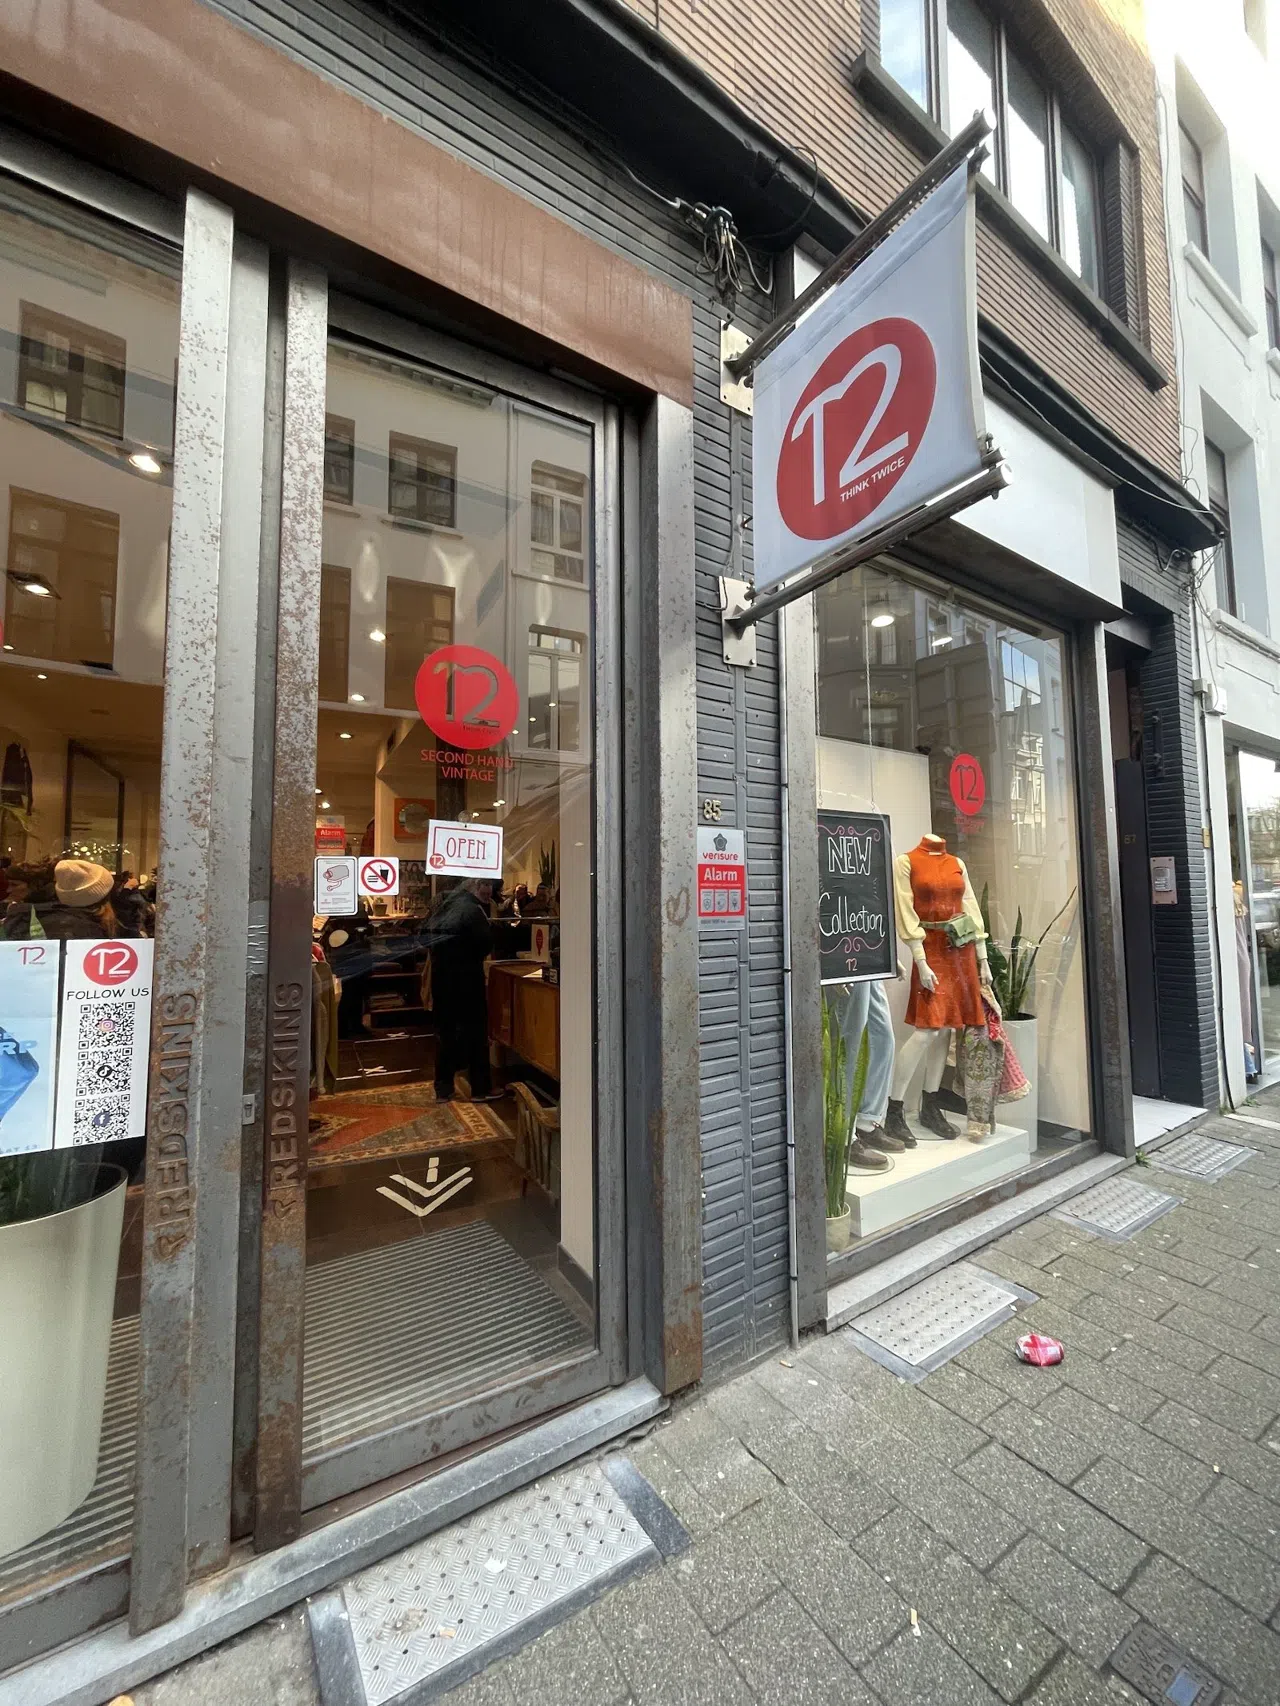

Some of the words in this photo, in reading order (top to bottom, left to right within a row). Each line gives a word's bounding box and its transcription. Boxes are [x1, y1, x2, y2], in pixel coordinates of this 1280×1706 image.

[840, 478, 870, 502] THINK
[871, 456, 905, 484] TWICE
[420, 749, 474, 766] SECOND
[477, 755, 514, 769] HAND
[441, 766, 496, 782] VINTAGE
[703, 799, 721, 821] 85
[446, 837, 487, 860] OPEN
[702, 851, 739, 861] verisure
[827, 836, 872, 876] NEW
[704, 867, 738, 881] Alarm
[818, 892, 886, 938] Collection
[66, 988, 126, 1001] FOLLOW
[131, 987, 150, 997] US
[269, 982, 304, 1191] REDSKINS
[154, 992, 198, 1229] REDSKINS
